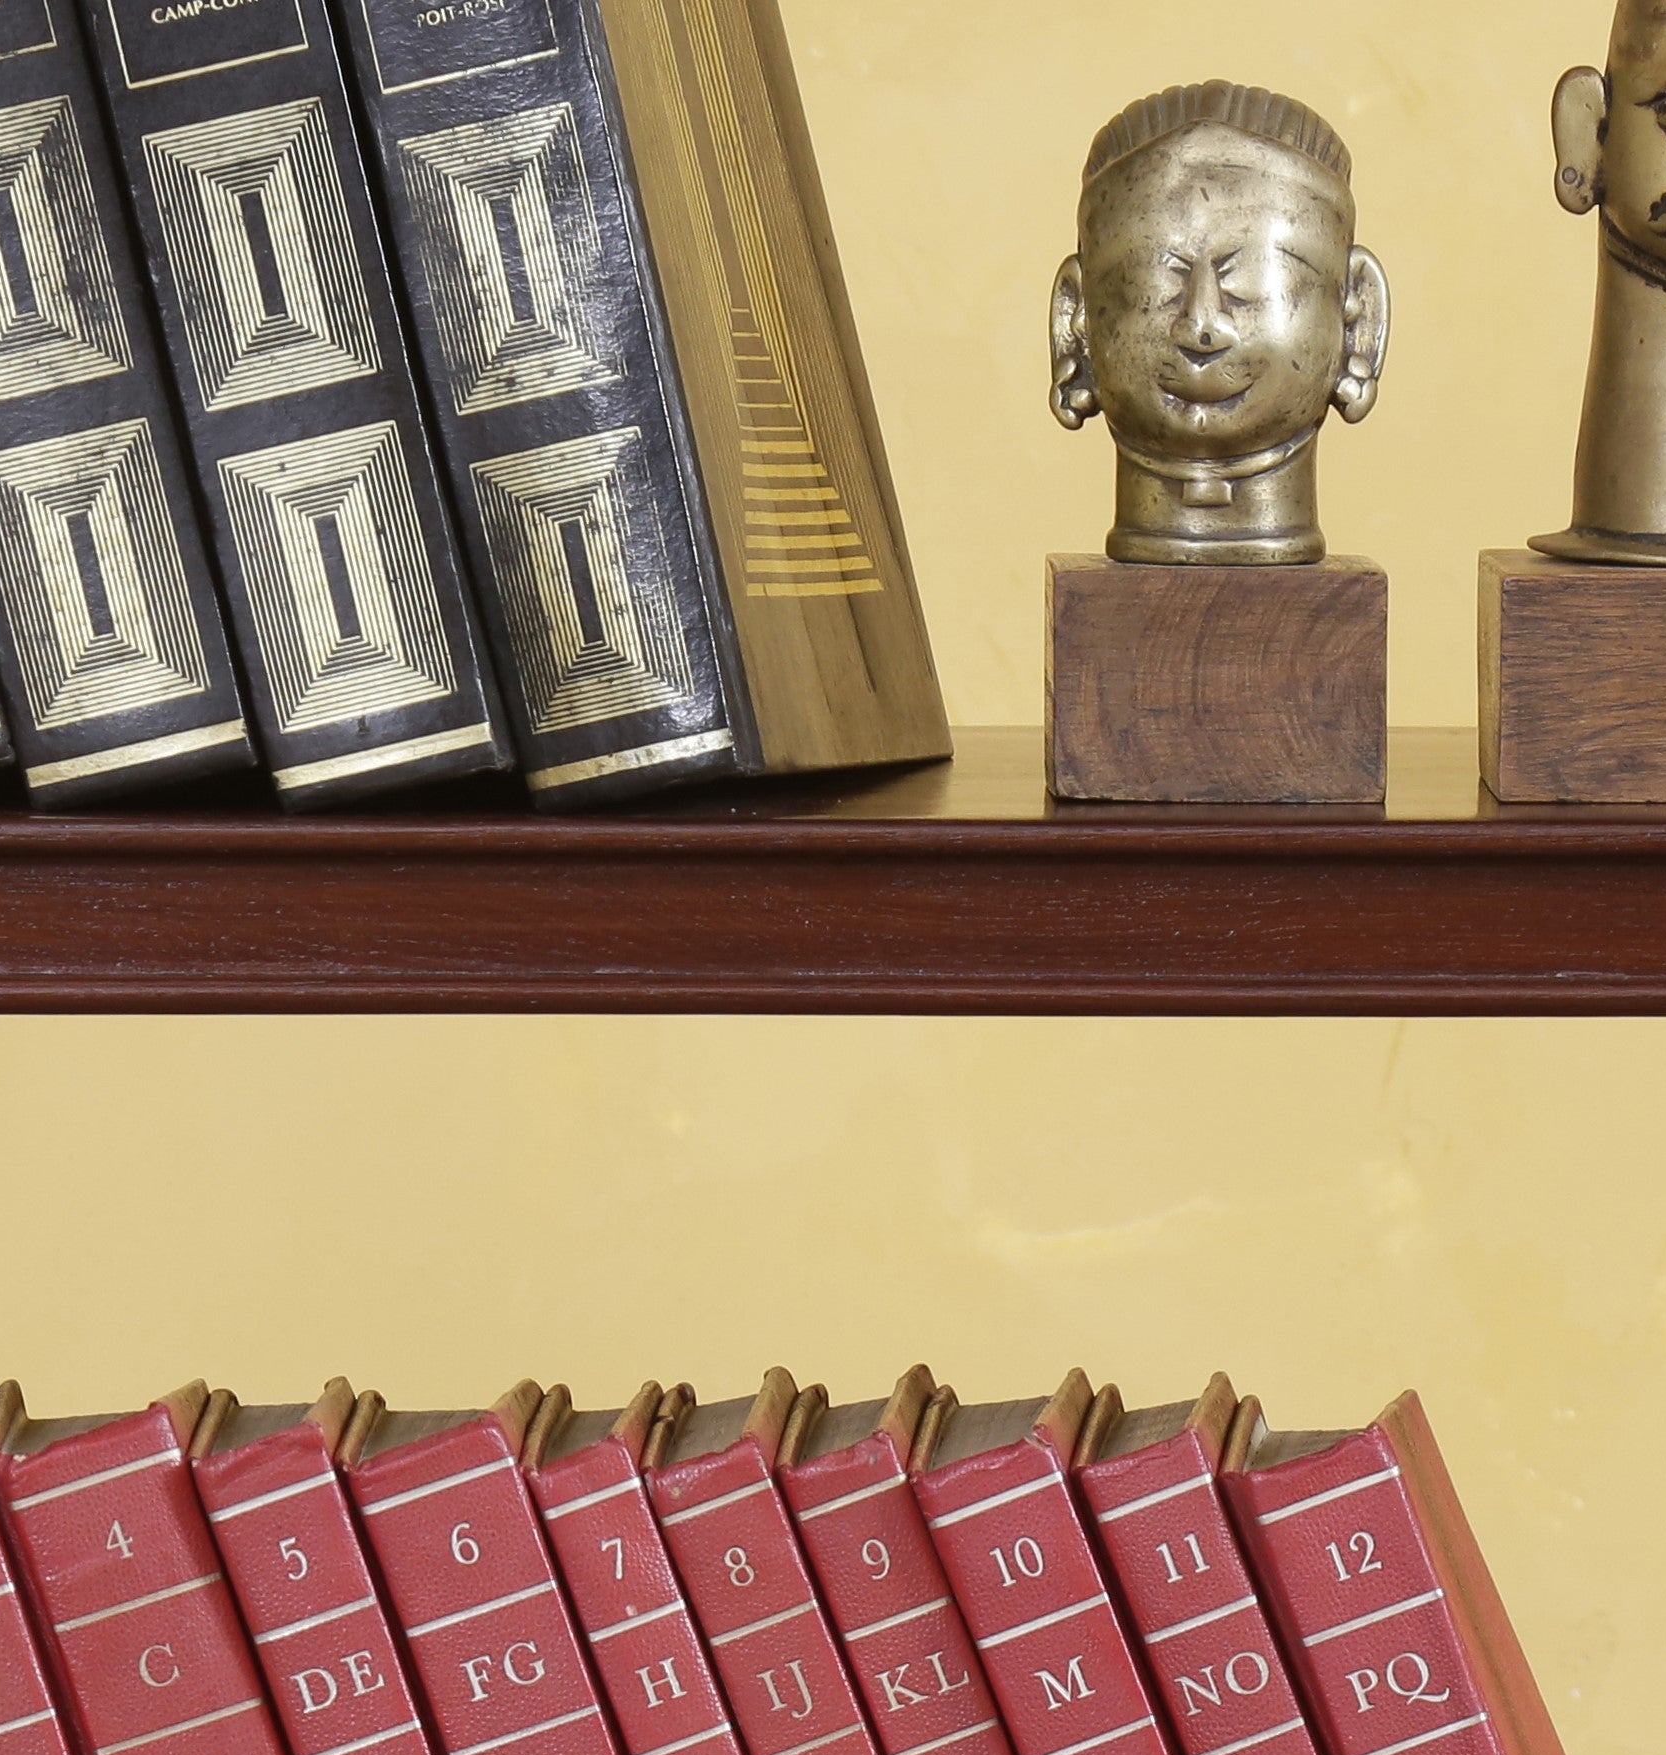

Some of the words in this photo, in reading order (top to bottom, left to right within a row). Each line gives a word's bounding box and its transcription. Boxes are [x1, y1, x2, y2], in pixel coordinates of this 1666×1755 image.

[106, 1520, 134, 1559] 4
[279, 1537, 308, 1581] 5
[451, 1523, 479, 1565] 6
[601, 1538, 623, 1580] 7
[862, 1539, 890, 1580] 9
[989, 1537, 1043, 1587] 10
[1156, 1534, 1210, 1583] 11
[1325, 1532, 1382, 1581] 12
[724, 1547, 754, 1586] 8
[139, 1643, 180, 1687] C
[290, 1650, 385, 1714] DE
[459, 1641, 545, 1702] FG
[635, 1657, 687, 1708] H
[875, 1652, 969, 1712] KL
[1033, 1655, 1096, 1710] M
[1174, 1651, 1270, 1716] NO
[1345, 1653, 1449, 1713] PQ
[757, 1660, 813, 1720] IJ
